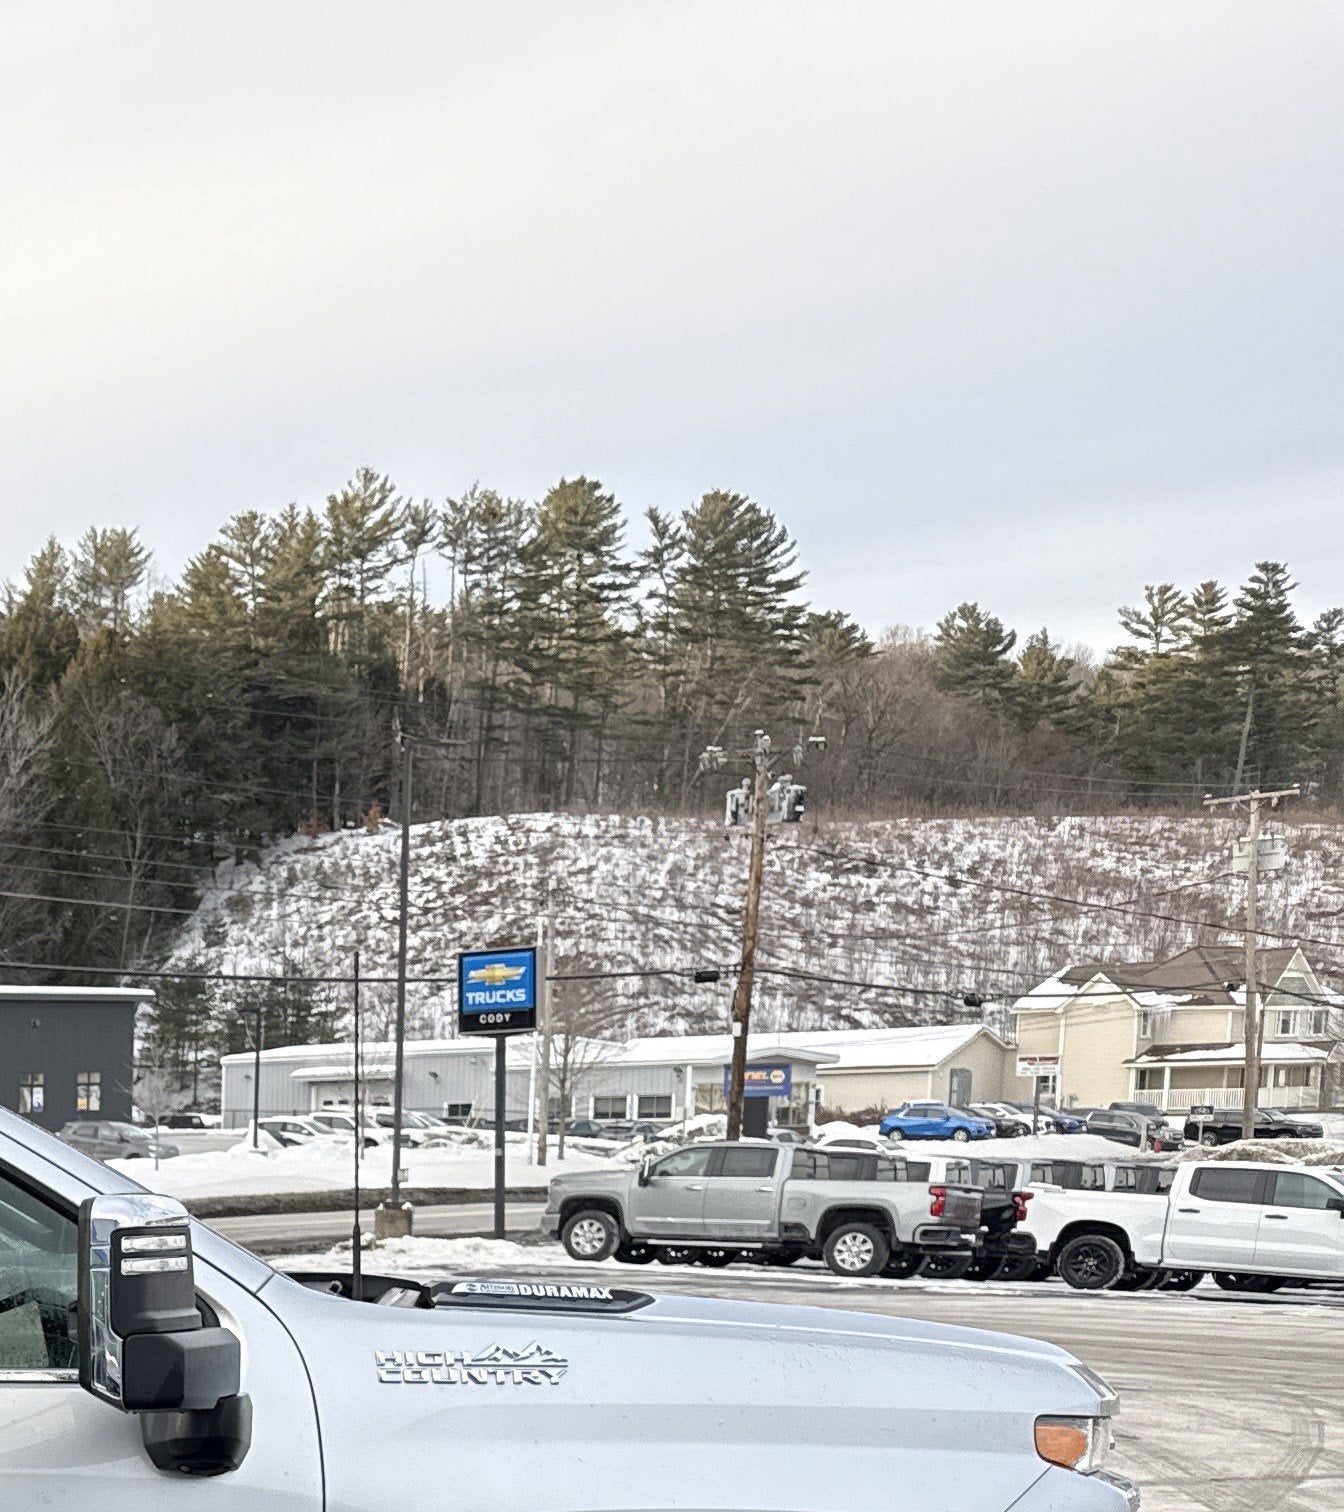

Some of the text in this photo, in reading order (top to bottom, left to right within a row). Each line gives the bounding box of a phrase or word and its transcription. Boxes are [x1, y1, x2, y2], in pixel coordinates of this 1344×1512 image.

[466, 988, 527, 1005] TRUCKS
[479, 1013, 511, 1024] CODY
[519, 1284, 613, 1299] DURAMAX
[375, 1350, 472, 1367] HIGH
[378, 1367, 568, 1386] COUNTRY
